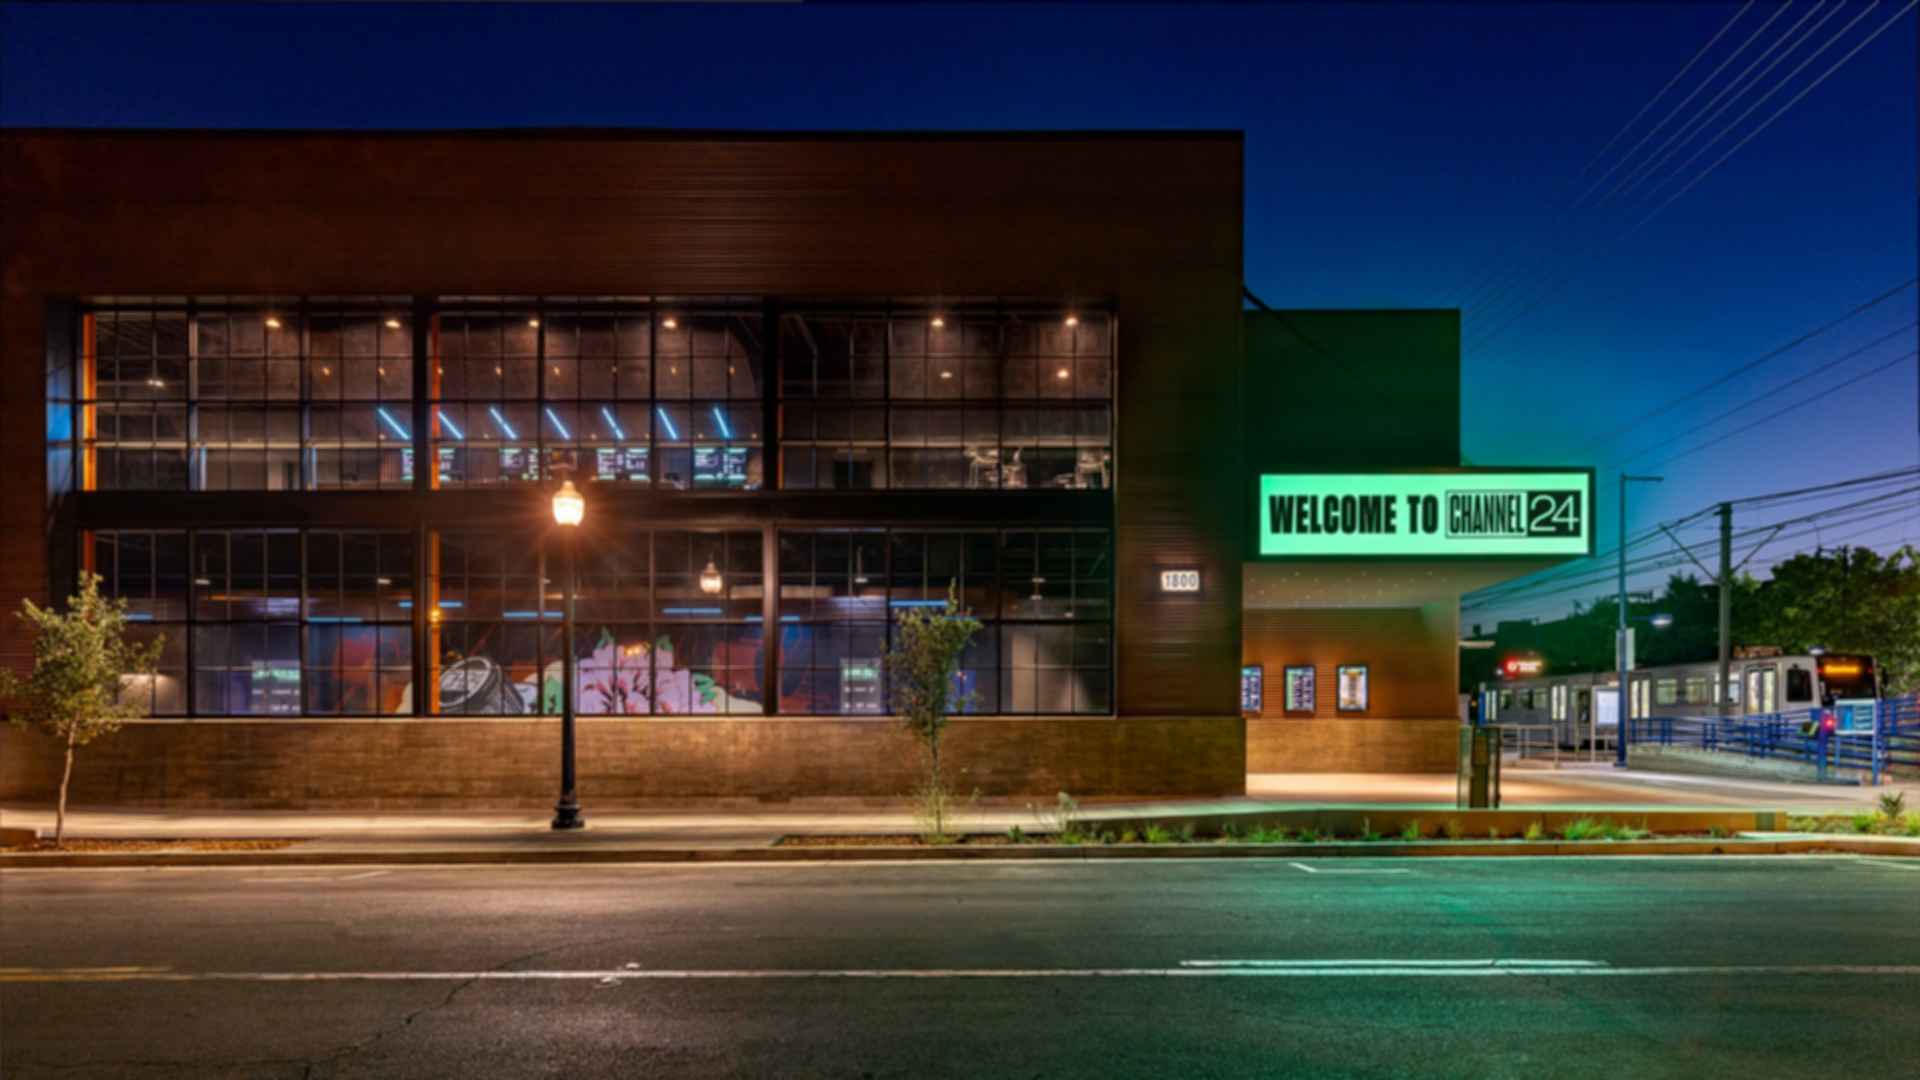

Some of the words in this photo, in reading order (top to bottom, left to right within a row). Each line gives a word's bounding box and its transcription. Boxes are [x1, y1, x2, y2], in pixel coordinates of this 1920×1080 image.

[1269, 494, 1397, 535] WELCOME
[1408, 494, 1439, 535] TO
[1450, 493, 1525, 534] CHANNEL
[1530, 494, 1579, 532] 24
[1164, 573, 1197, 588] 1800
